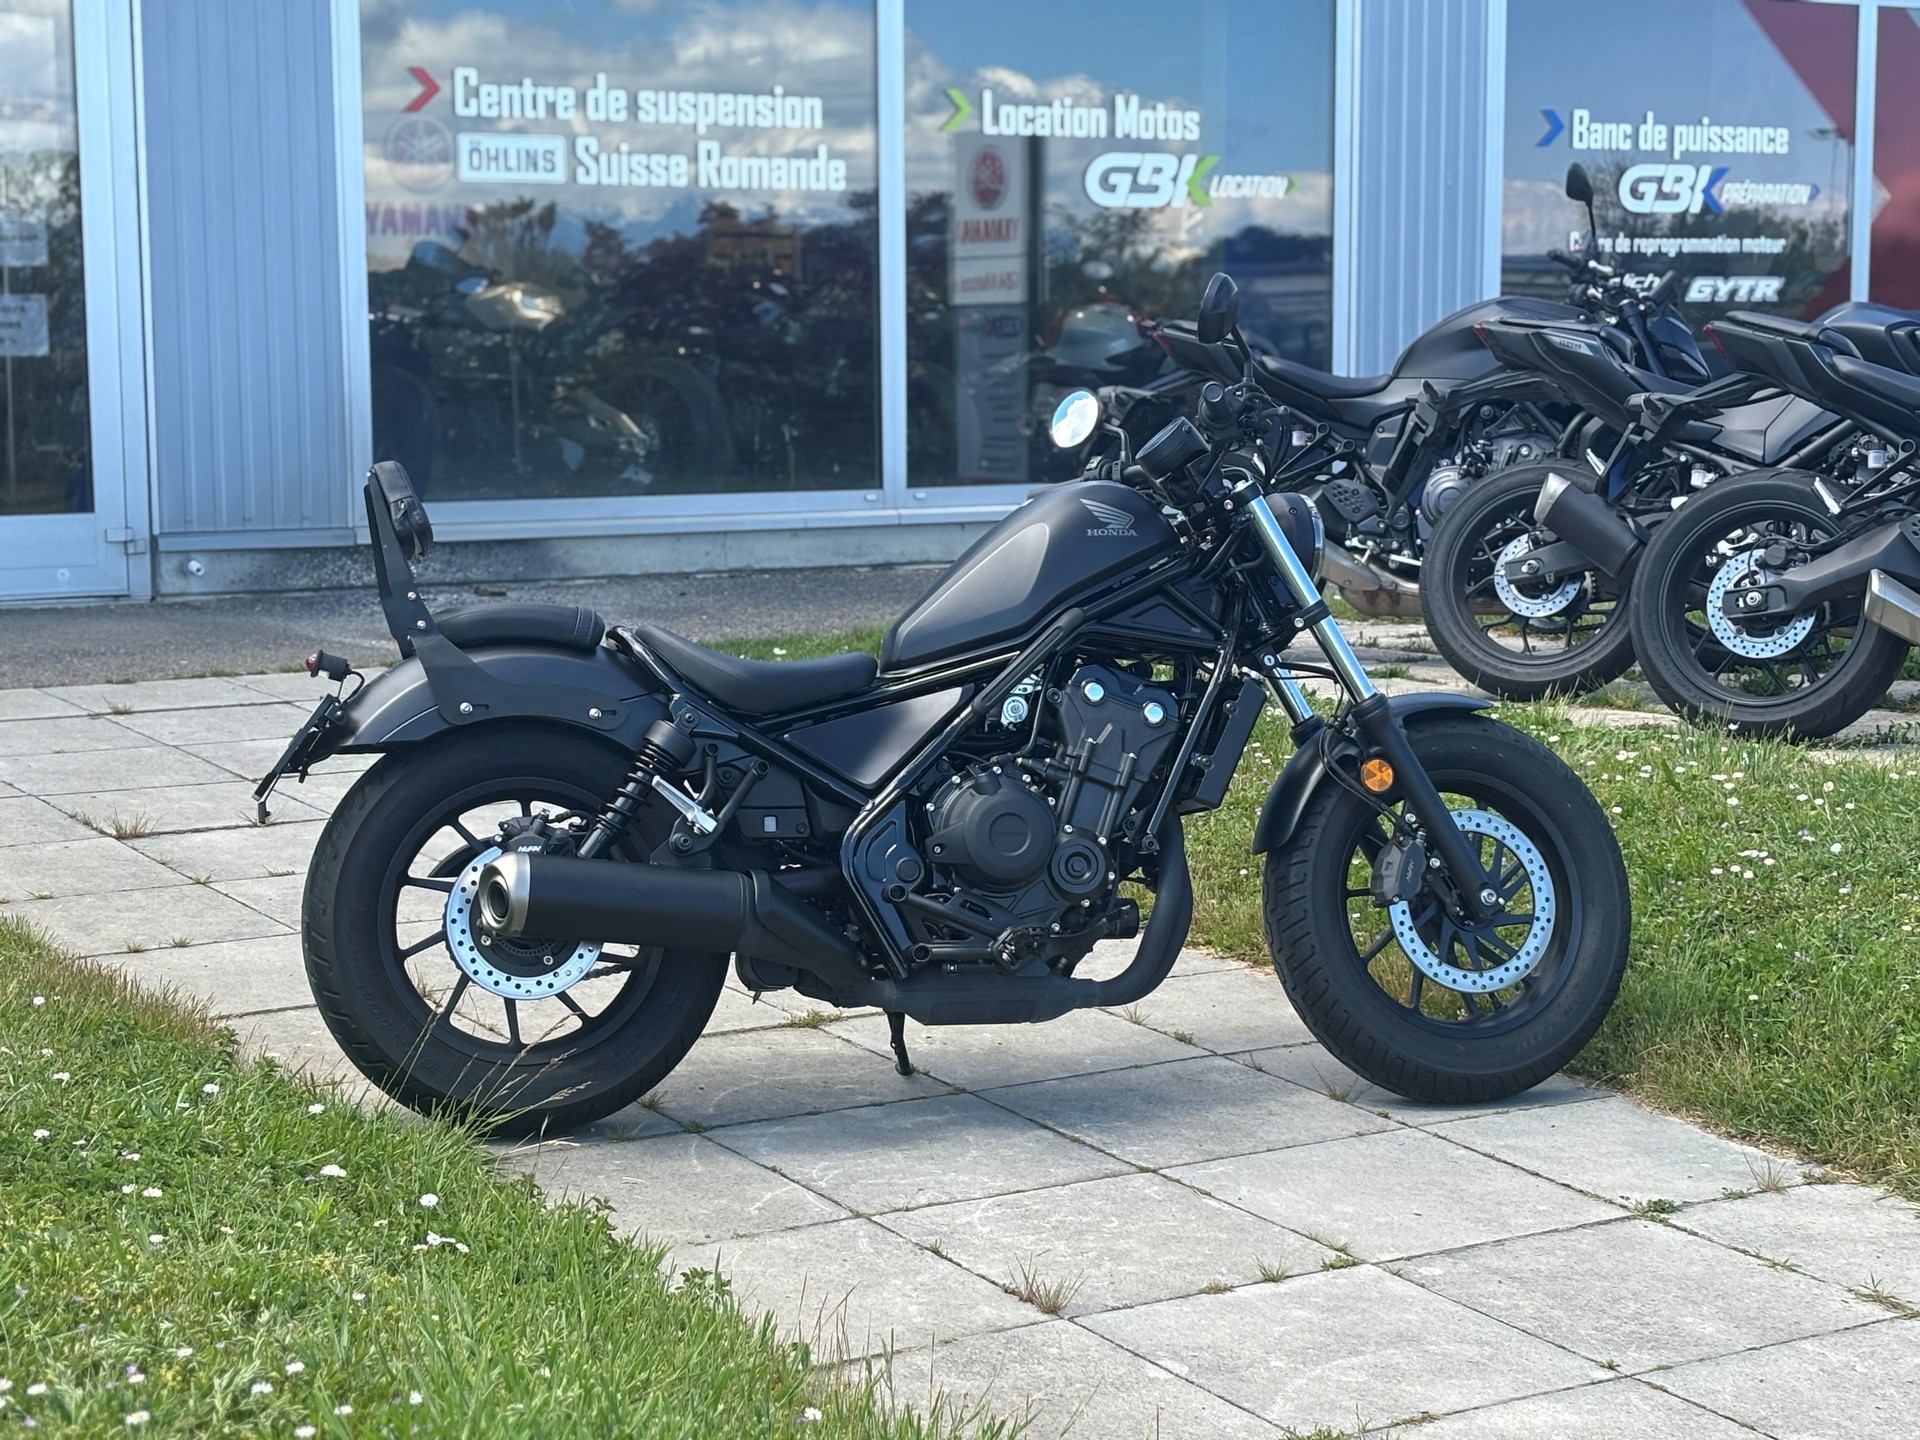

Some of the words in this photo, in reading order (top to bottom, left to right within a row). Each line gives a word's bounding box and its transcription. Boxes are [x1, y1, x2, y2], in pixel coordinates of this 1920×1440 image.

[454, 66, 576, 121] Centre
[586, 73, 629, 122] de
[637, 85, 823, 134] suspension
[982, 88, 1108, 139] Location
[1115, 93, 1201, 142] Motos
[468, 138, 558, 174] ÖHLINS
[1572, 108, 1632, 151] Banc
[1638, 111, 1667, 153] de
[1673, 116, 1790, 160] puissance
[575, 135, 690, 187] Suisse
[697, 139, 847, 192] Romande
[1084, 152, 1220, 208] GBK
[1208, 174, 1290, 200] LOCATION
[1618, 163, 1730, 215] GBK
[1720, 179, 1812, 206] PRÉPARATION
[1614, 231, 1631, 253] de
[1633, 234, 1741, 258] reprogrammation
[1742, 235, 1787, 254] moteur
[1685, 276, 1785, 302] GYTR
[1086, 528, 1138, 537] HONDA
